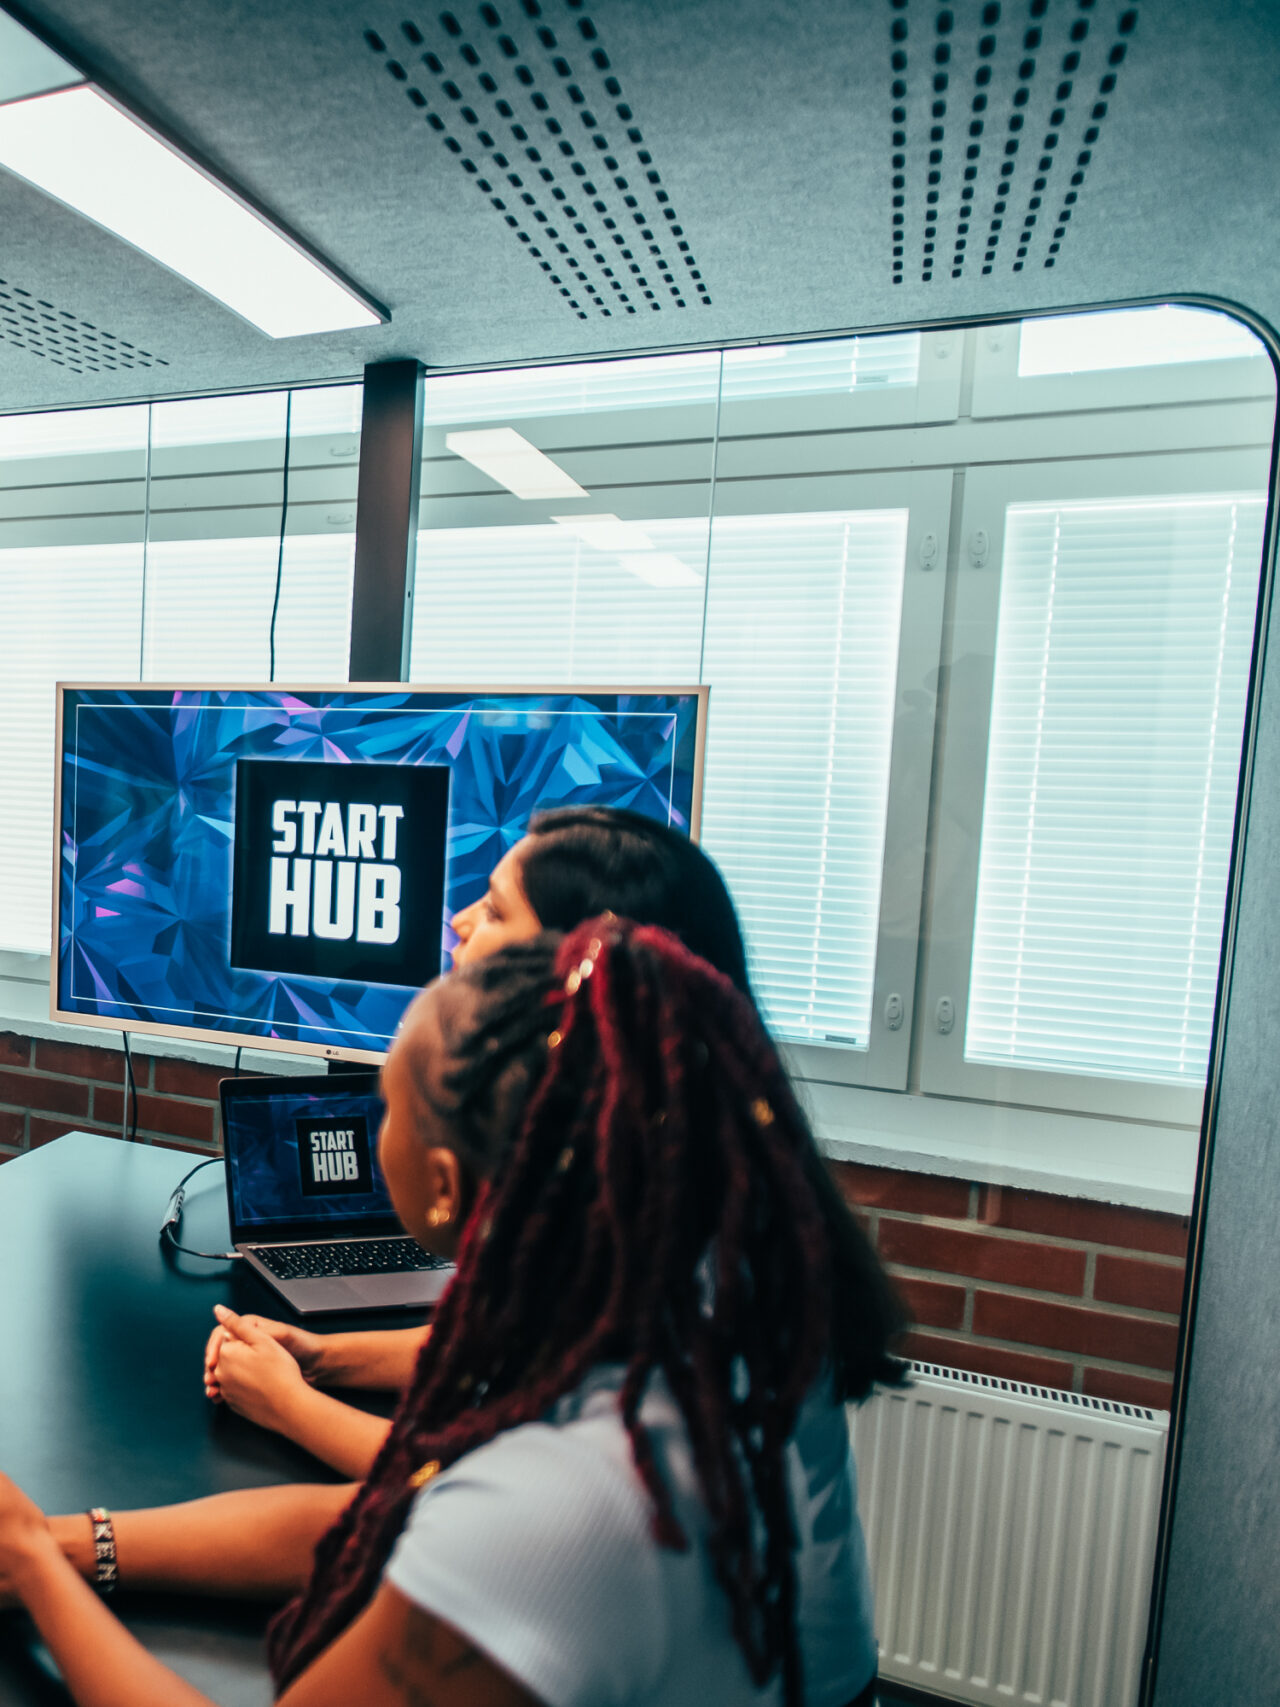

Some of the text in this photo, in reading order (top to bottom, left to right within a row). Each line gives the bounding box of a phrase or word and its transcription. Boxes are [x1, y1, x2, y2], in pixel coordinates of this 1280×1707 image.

[272, 800, 405, 860] START
[269, 856, 402, 945] HUB
[310, 1130, 355, 1151] START
[312, 1151, 360, 1182] HUB
